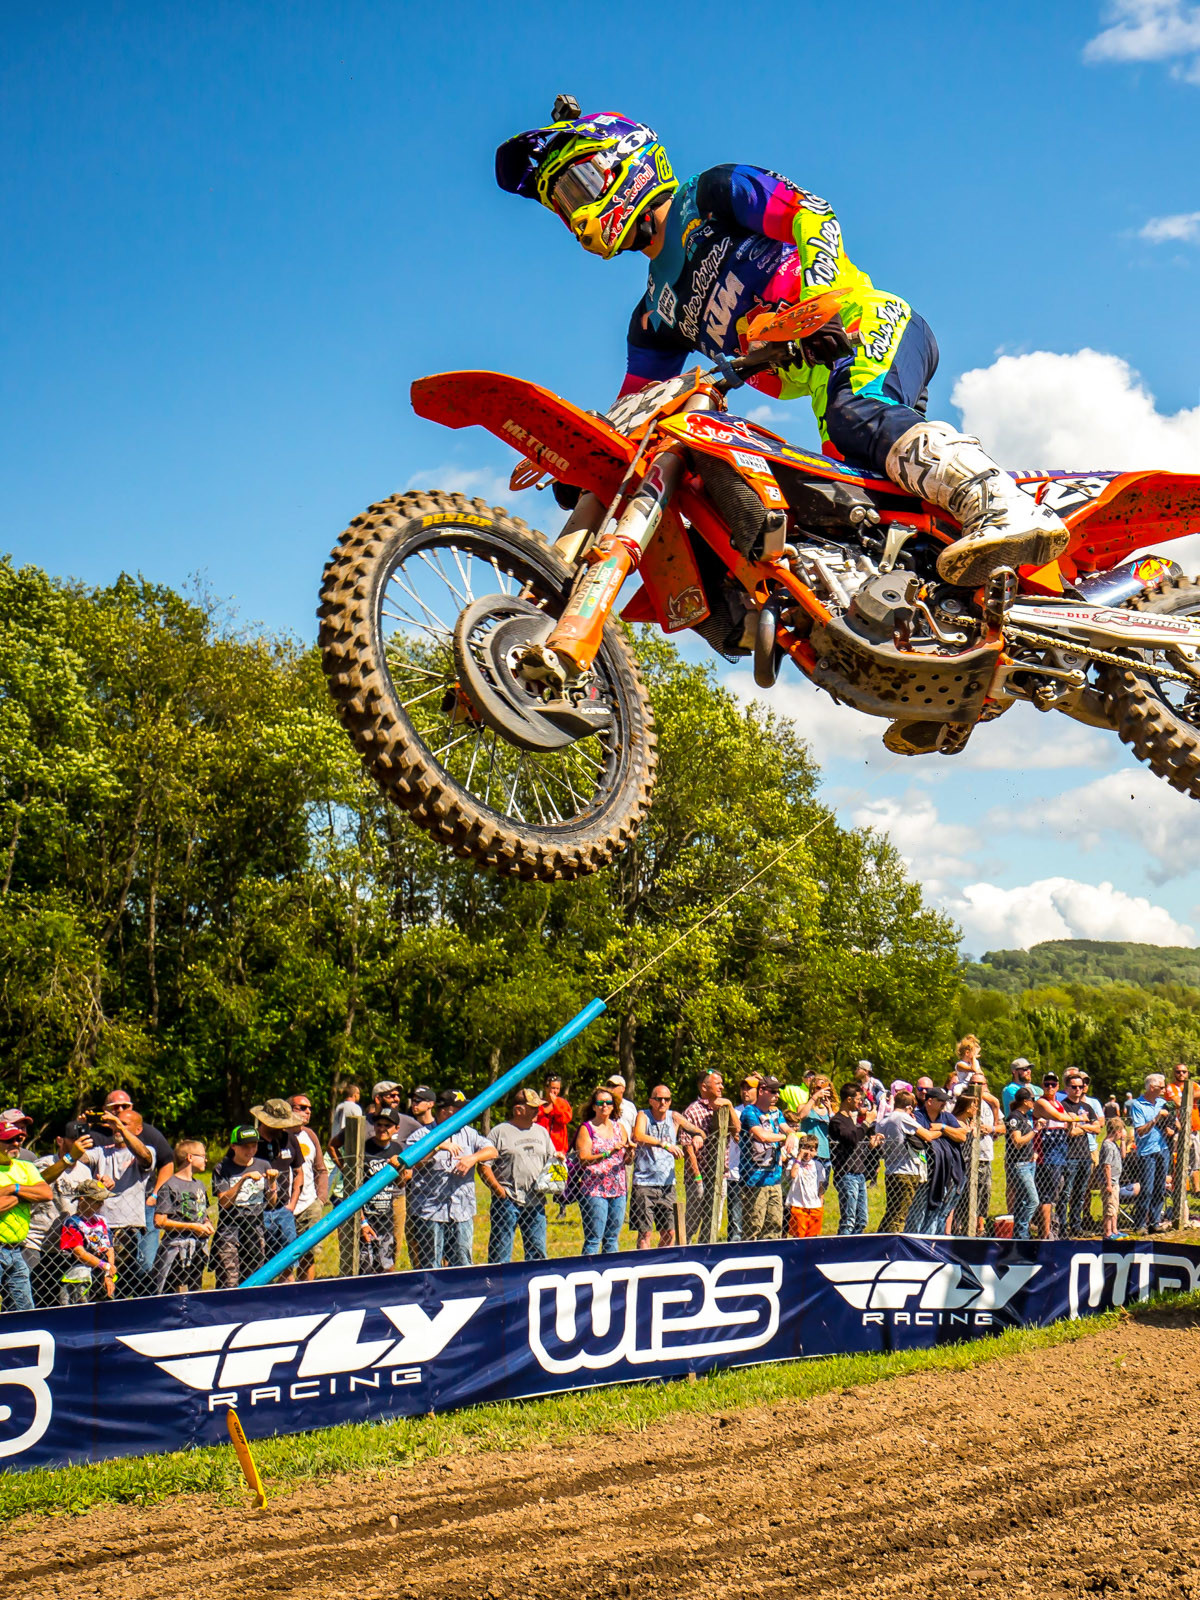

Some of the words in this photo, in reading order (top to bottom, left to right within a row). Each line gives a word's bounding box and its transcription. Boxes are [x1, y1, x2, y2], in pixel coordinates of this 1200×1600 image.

[703, 270, 745, 349] KTM
[502, 419, 570, 472] METHOD
[422, 513, 493, 527] DUNLOP
[815, 1259, 1043, 1311] FLY
[527, 1254, 784, 1375] WPS
[862, 1310, 994, 1327] RACING
[116, 1295, 488, 1391] FLY
[208, 1365, 423, 1412] RACING
